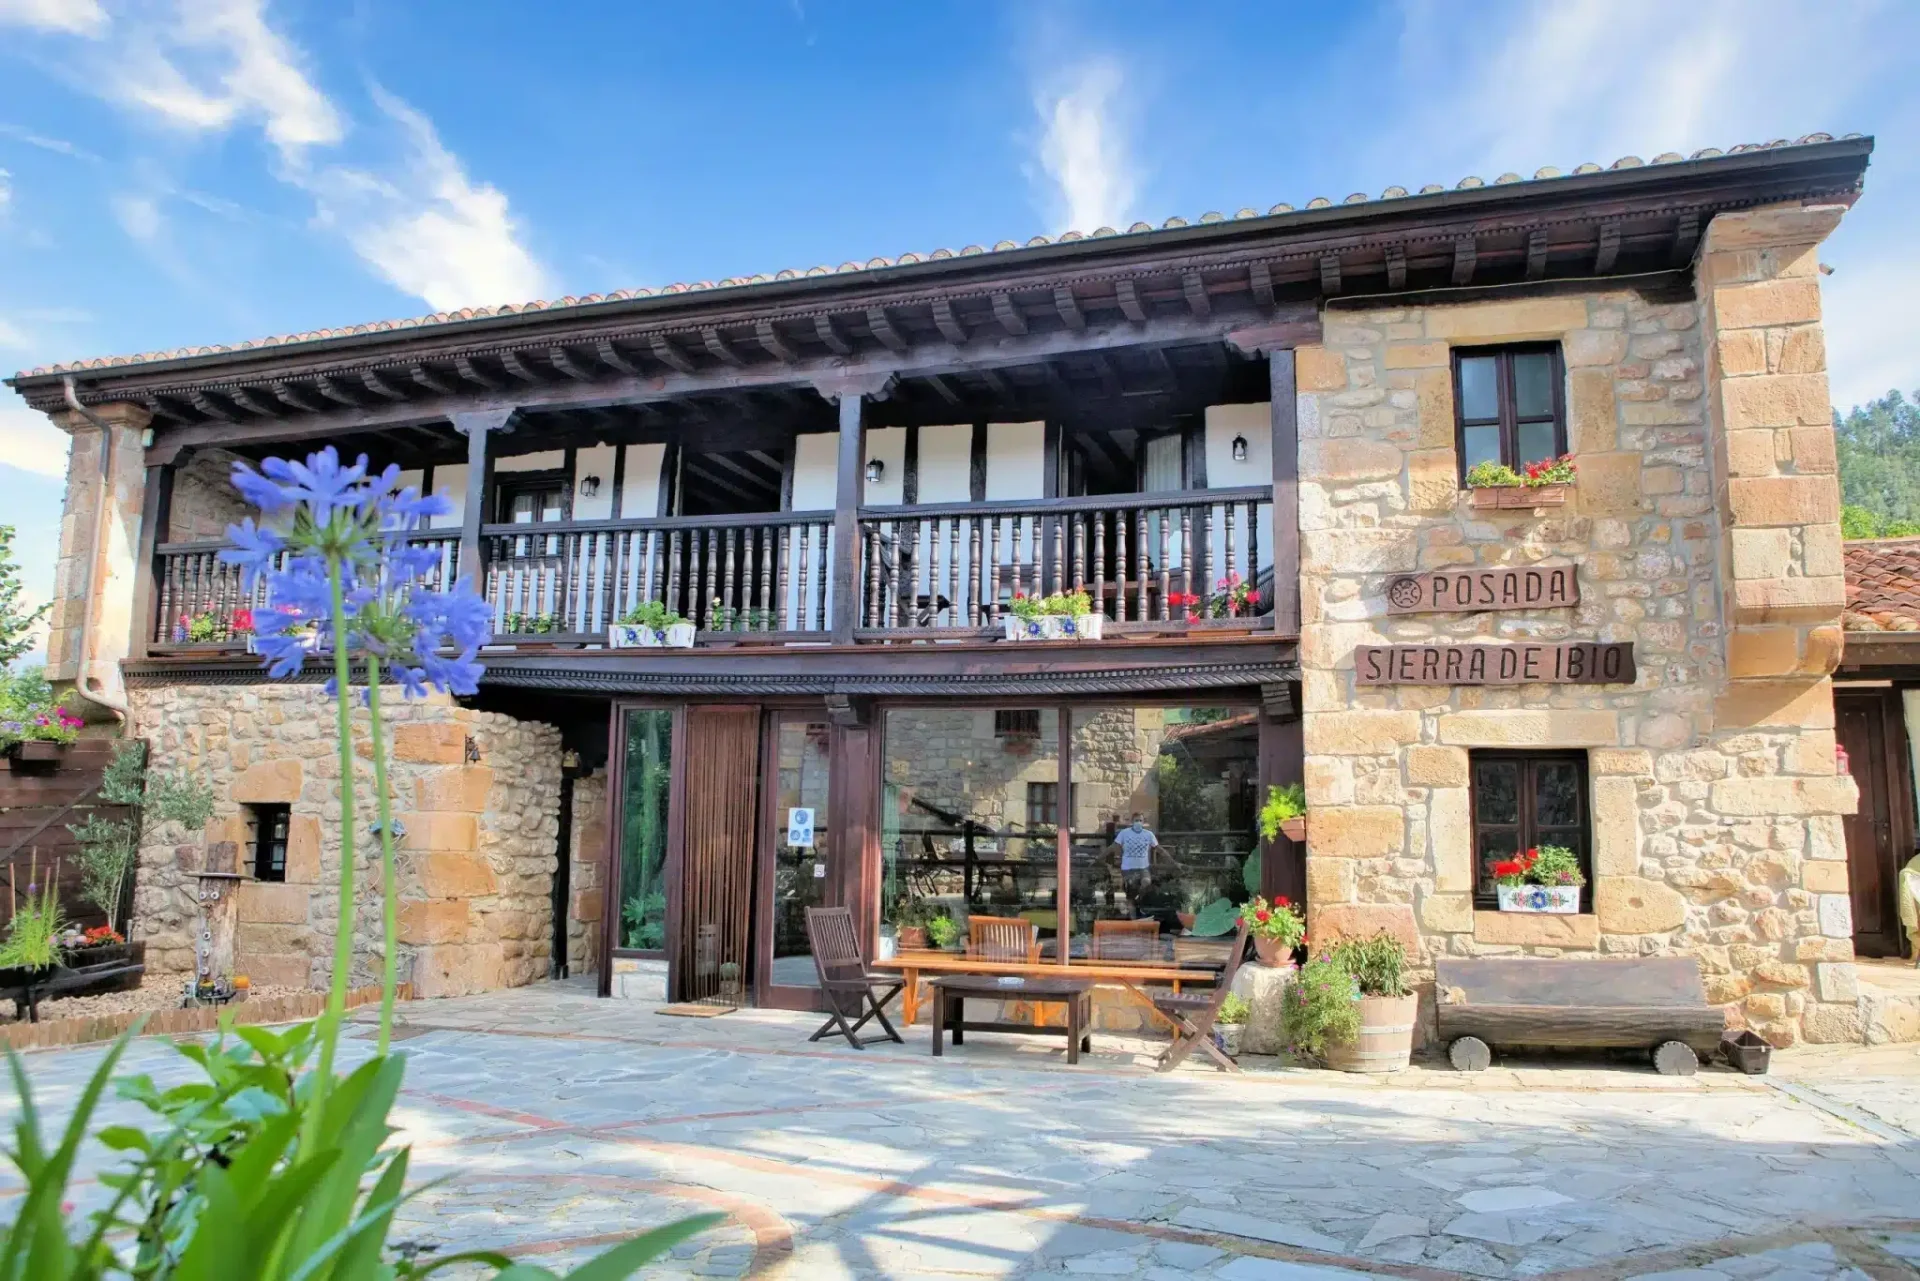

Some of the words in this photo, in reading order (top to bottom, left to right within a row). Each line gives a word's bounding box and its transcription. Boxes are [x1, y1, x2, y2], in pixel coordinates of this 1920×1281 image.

[1432, 570, 1566, 607] POSADA
[1365, 648, 1485, 681] SIERRA
[1499, 647, 1540, 680] DE
[1555, 646, 1621, 680] IBIO
